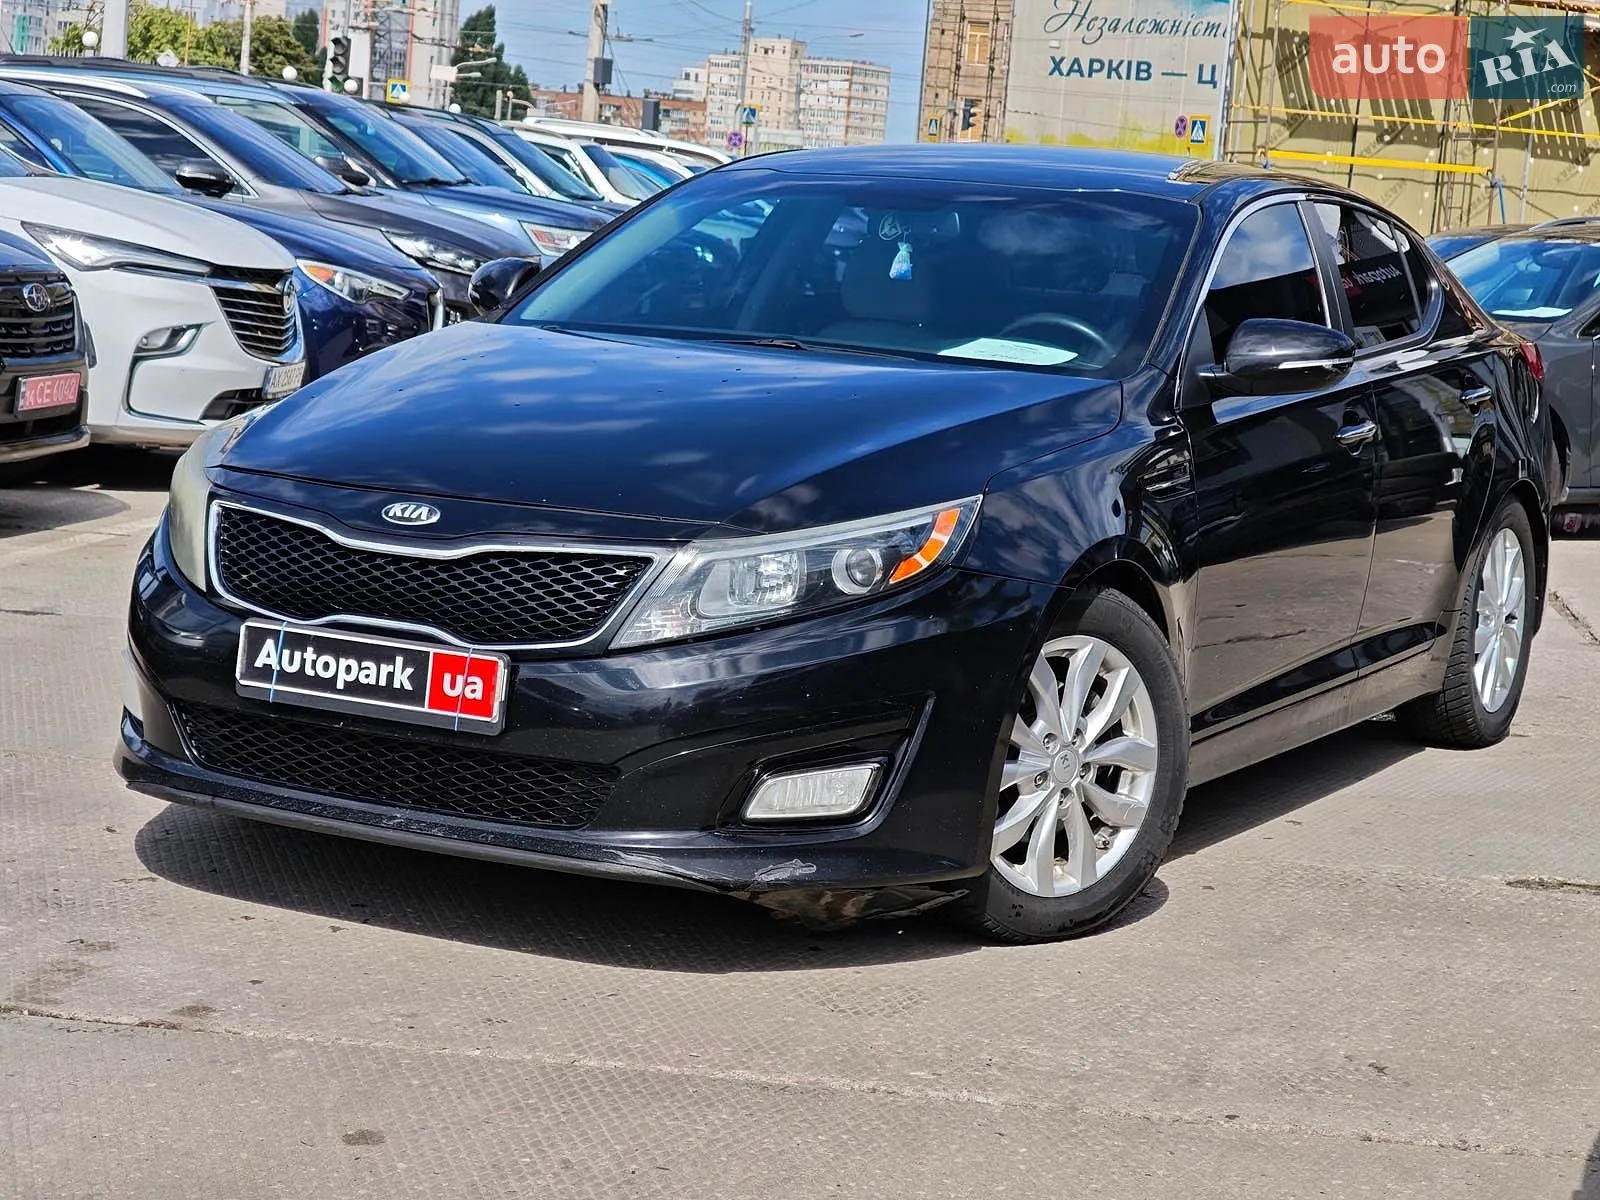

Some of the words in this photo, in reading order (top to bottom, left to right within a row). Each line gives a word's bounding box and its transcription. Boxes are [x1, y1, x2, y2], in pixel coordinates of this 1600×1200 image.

[1048, 55, 1153, 81] ХАРКІВ
[387, 502, 432, 522] KIA
[254, 638, 416, 690] Autopark
[442, 672, 485, 701] ua
